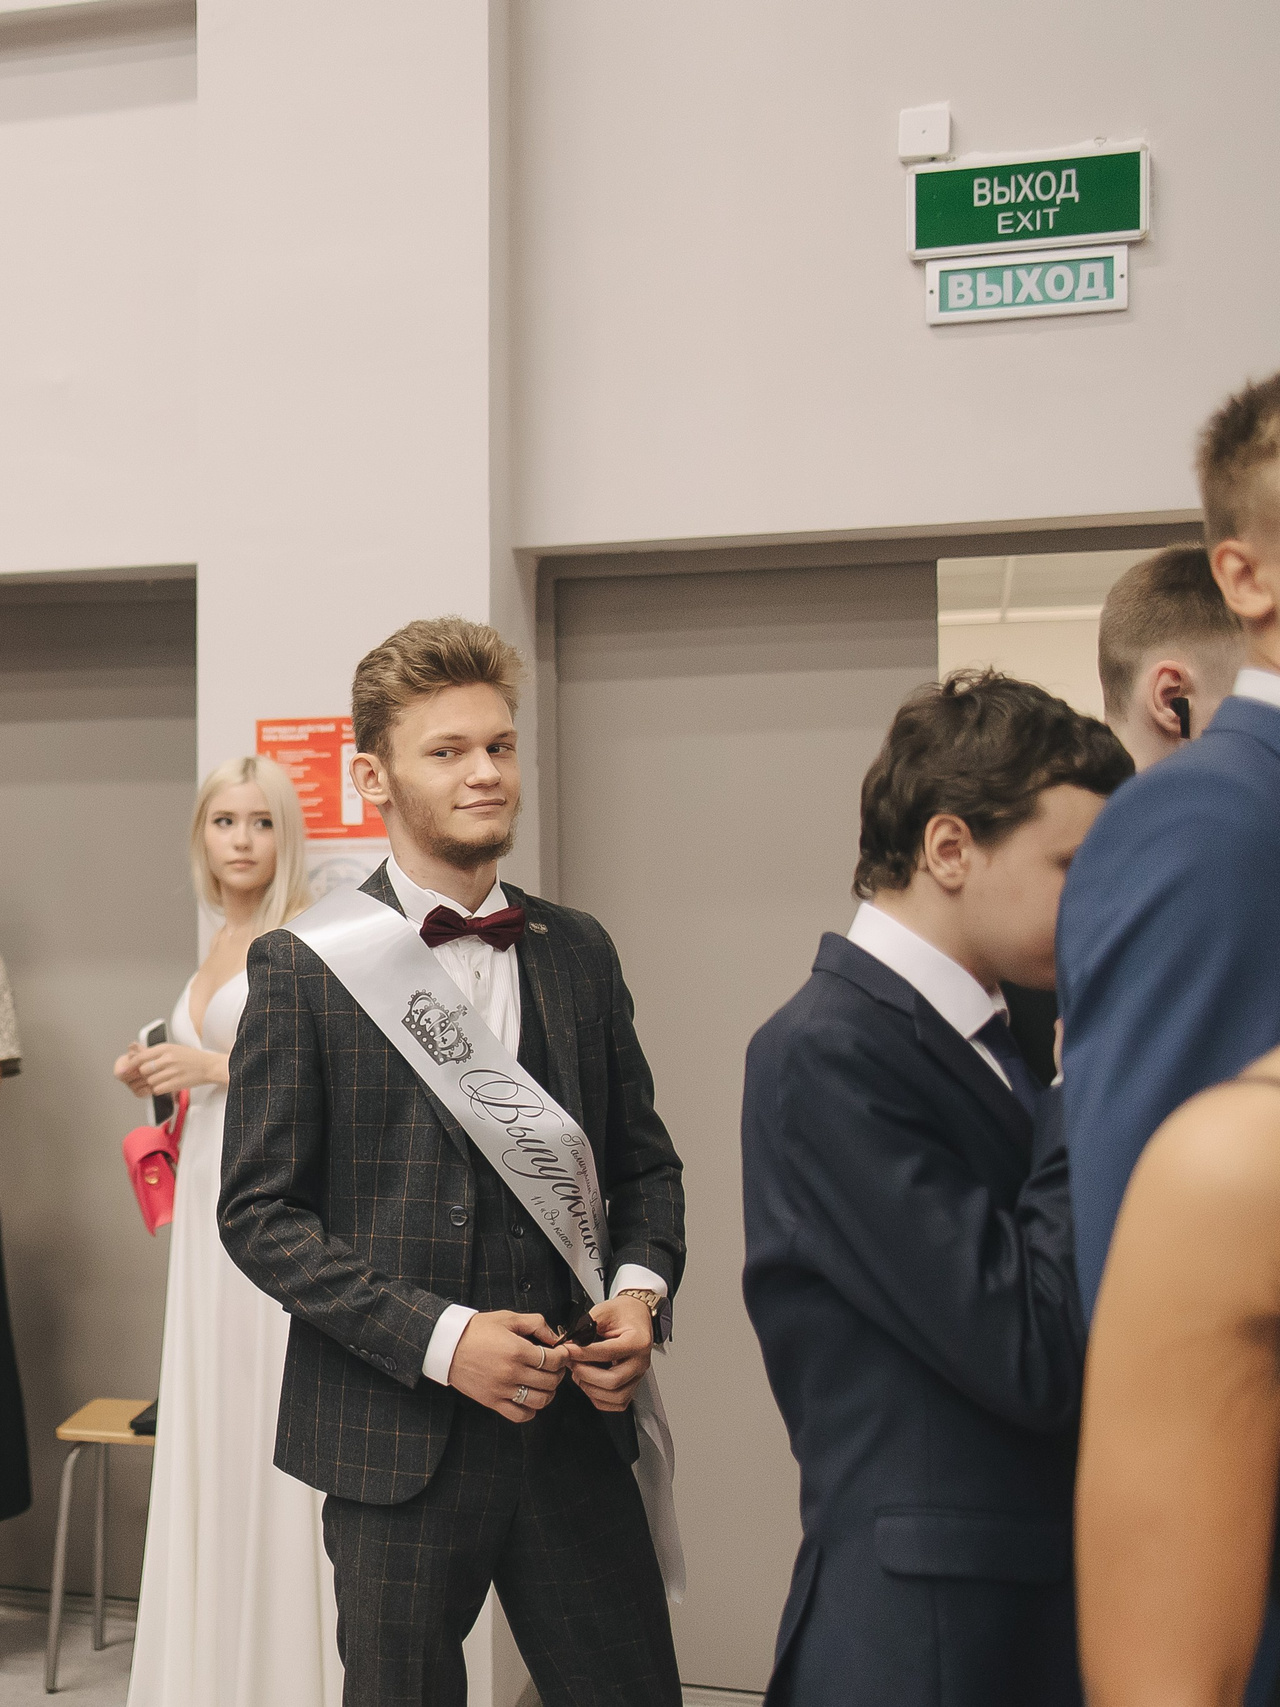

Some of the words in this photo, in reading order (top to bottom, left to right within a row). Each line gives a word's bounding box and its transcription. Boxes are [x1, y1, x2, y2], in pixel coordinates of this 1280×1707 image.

[973, 168, 1080, 207] ВЫХОД
[996, 207, 1061, 235] EXIT
[947, 262, 1108, 309] ВЫХОД
[458, 1069, 601, 1260] Выпускник
